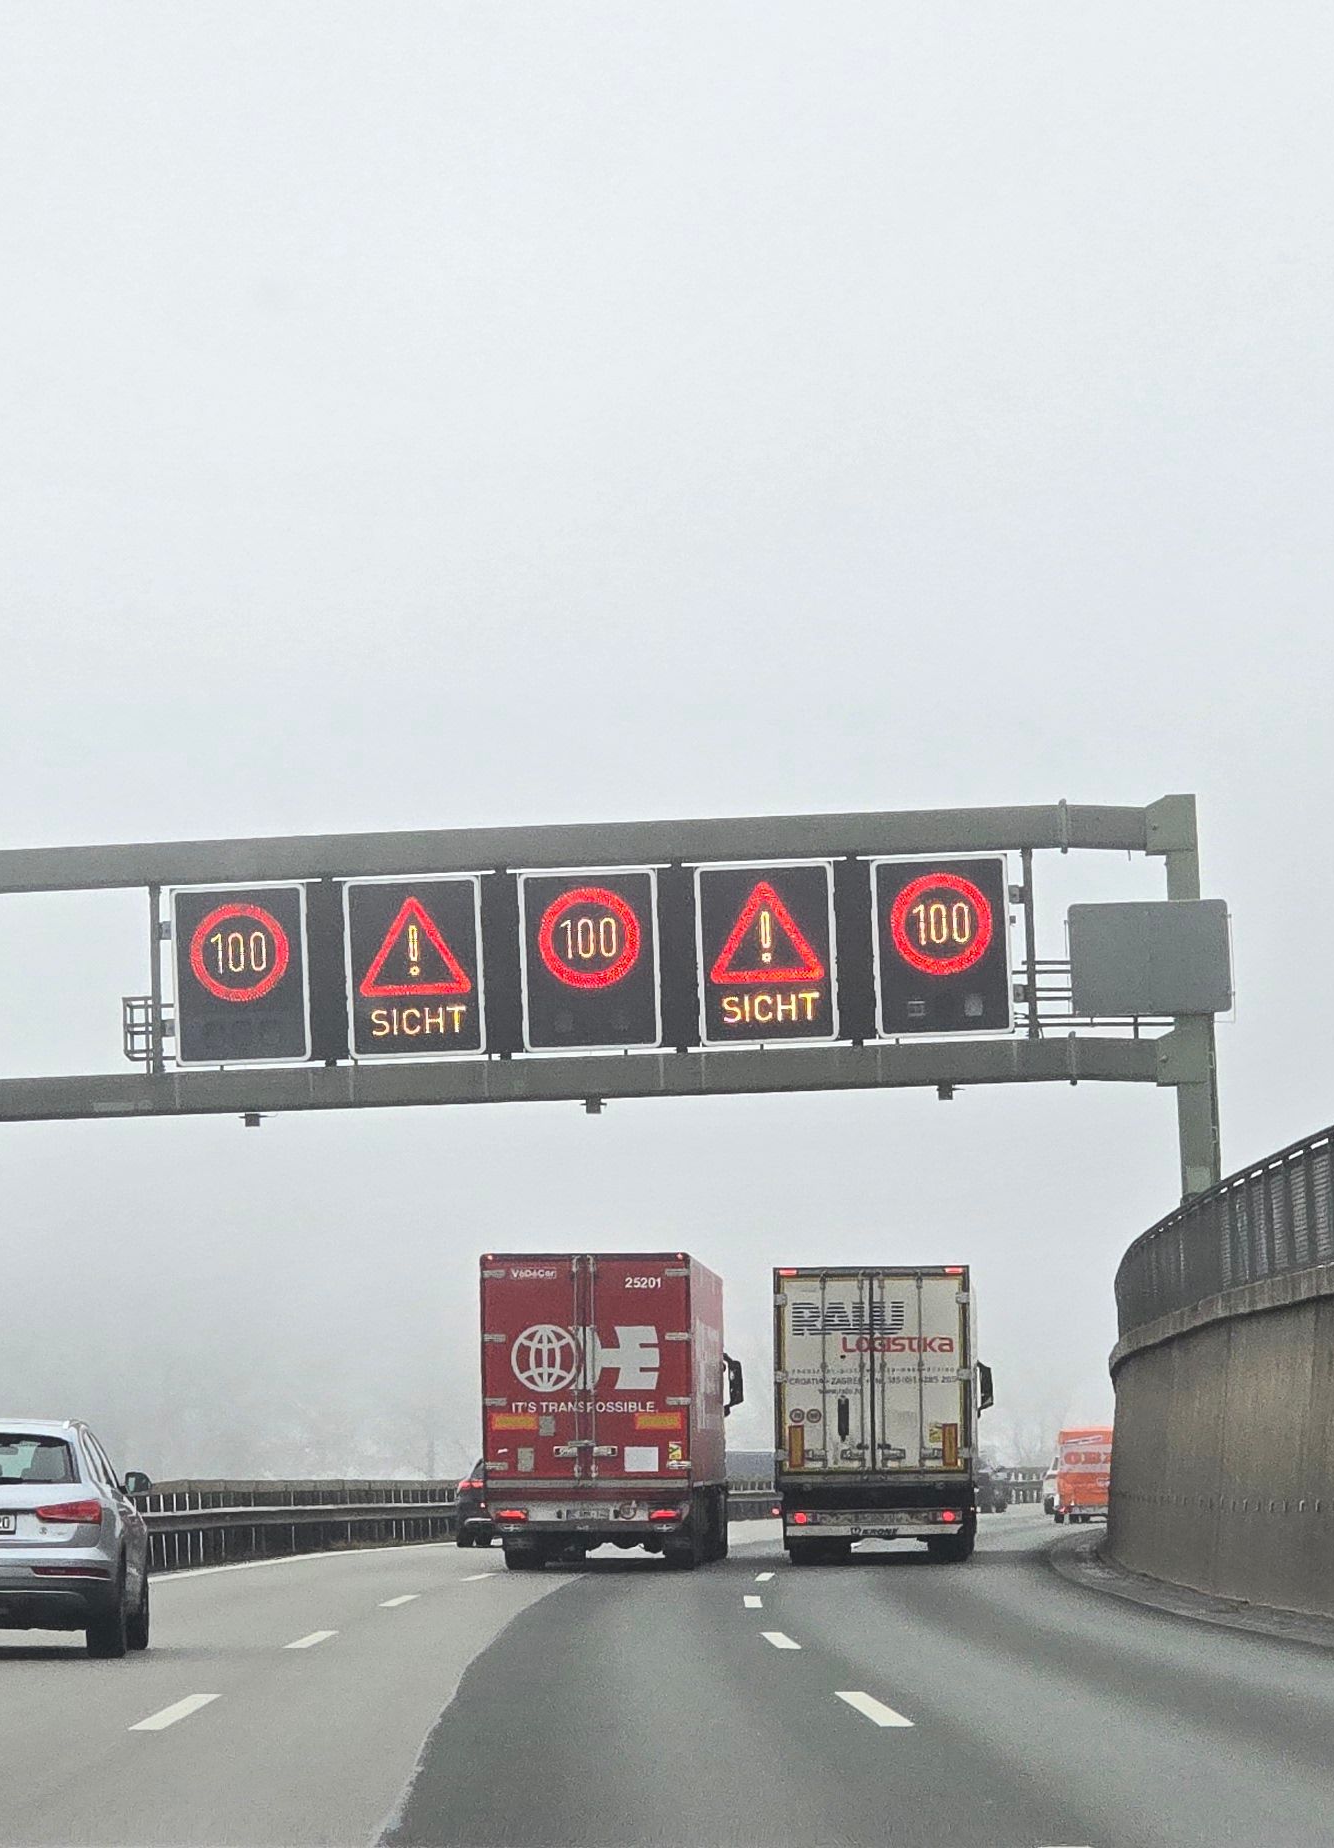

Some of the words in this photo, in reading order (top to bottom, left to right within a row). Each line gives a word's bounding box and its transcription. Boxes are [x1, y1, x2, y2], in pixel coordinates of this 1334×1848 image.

[559, 917, 618, 960] 100
[911, 902, 970, 946] 100
[210, 931, 267, 975] 100
[370, 1005, 467, 1037] SICHT
[721, 990, 821, 1024] SICHT
[624, 1276, 662, 1289] 25201
[511, 1401, 537, 1413] IT'S
